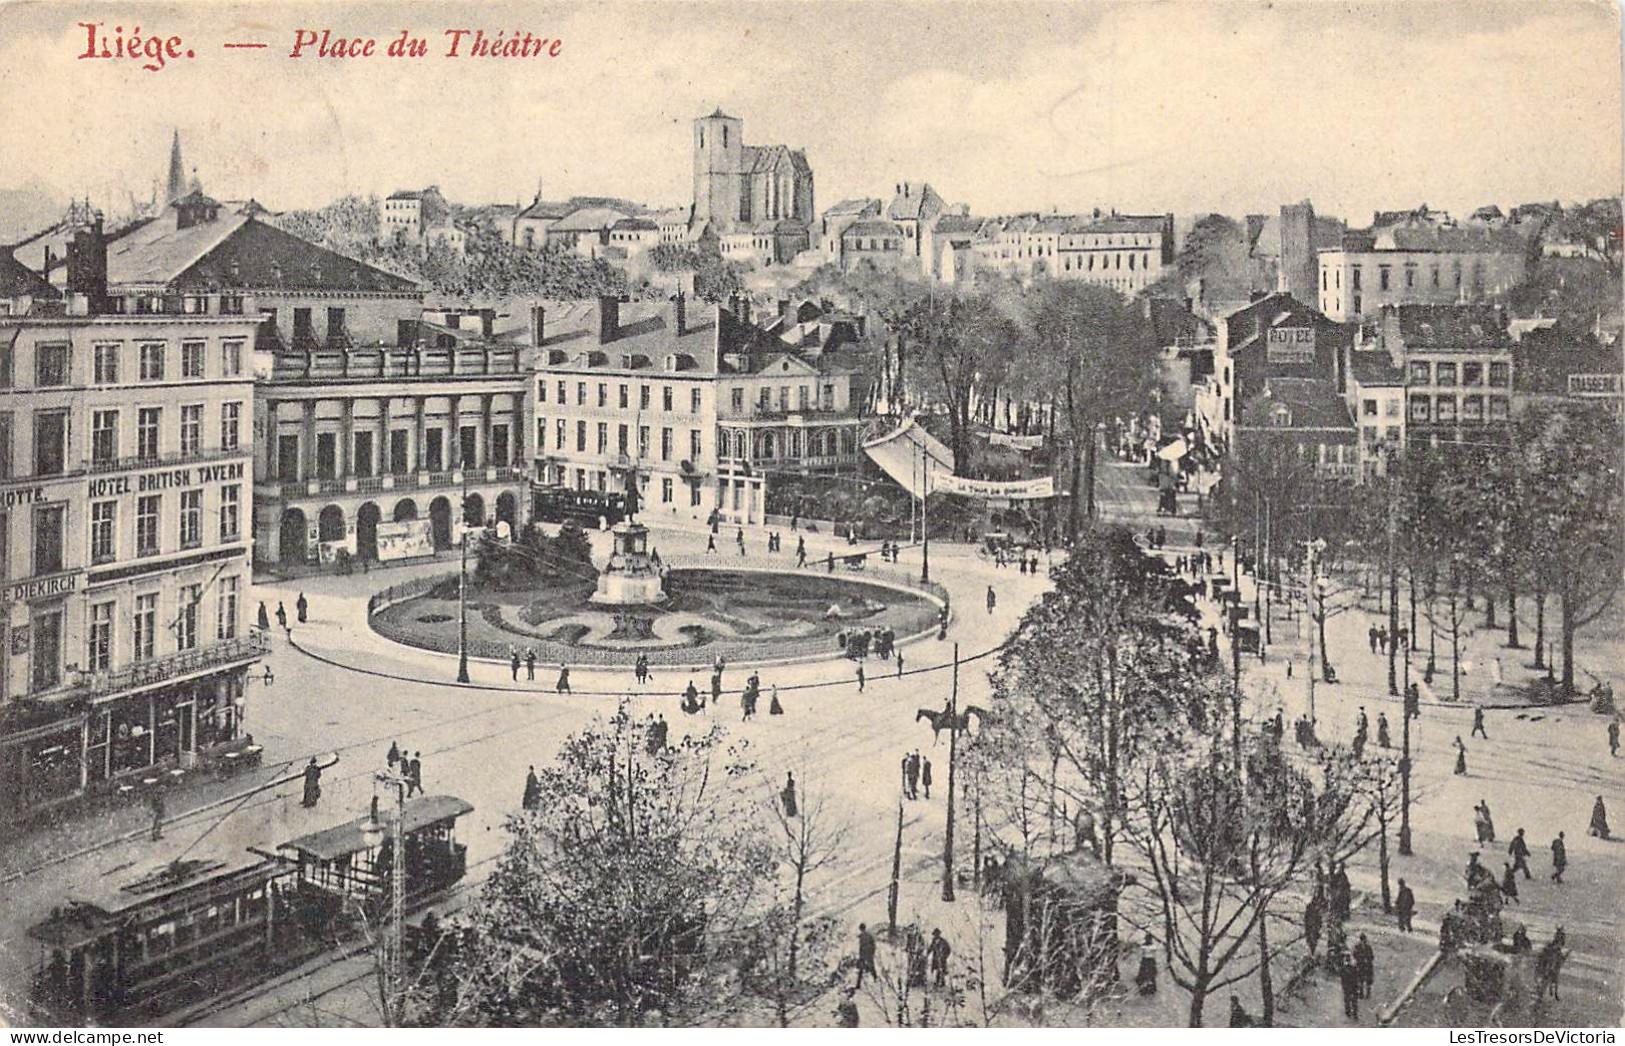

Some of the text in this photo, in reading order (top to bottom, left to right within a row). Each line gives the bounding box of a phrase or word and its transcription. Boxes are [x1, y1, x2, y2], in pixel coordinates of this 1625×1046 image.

[88, 462, 244, 498] HOTEL BRITISH TAVERN
[15, 575, 75, 600] DIEKIRCH
